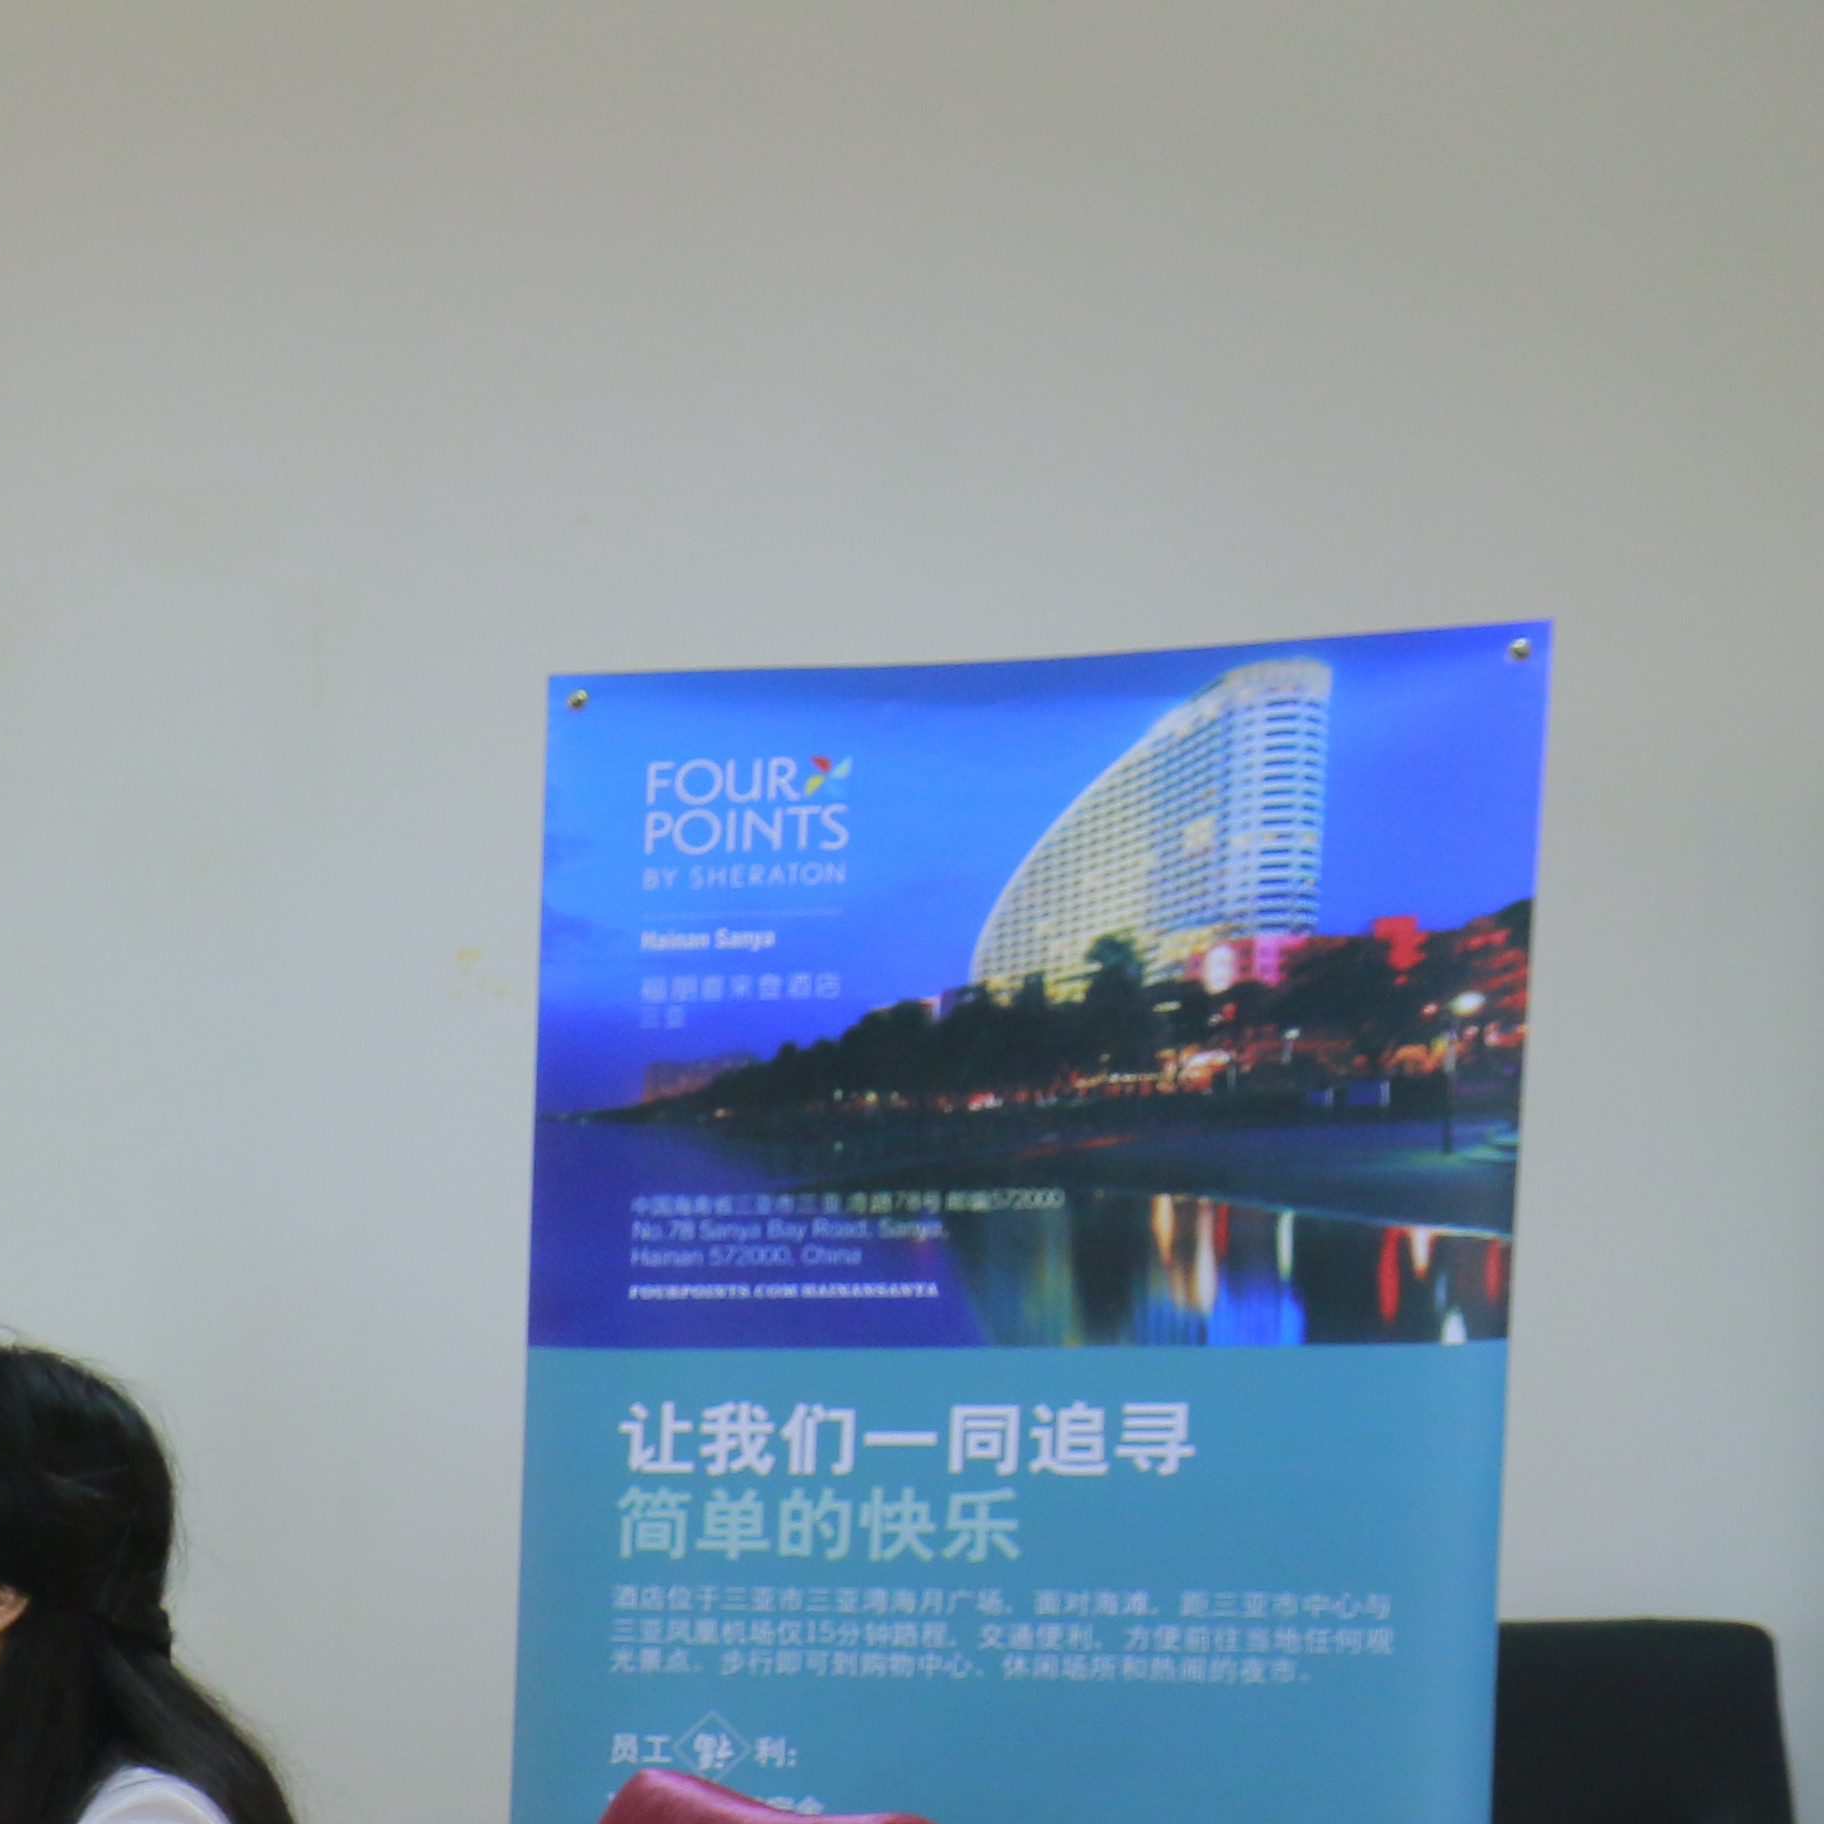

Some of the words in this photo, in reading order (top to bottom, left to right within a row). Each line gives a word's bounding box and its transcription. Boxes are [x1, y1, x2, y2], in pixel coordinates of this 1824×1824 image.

[645, 756, 801, 805] FOUR
[643, 803, 850, 855] POINTS
[642, 866, 679, 891] BY
[688, 861, 848, 890] SHERATON
[617, 1401, 1197, 1477] 让我们一同追寻
[616, 1487, 1023, 1562] 简单的快乐
